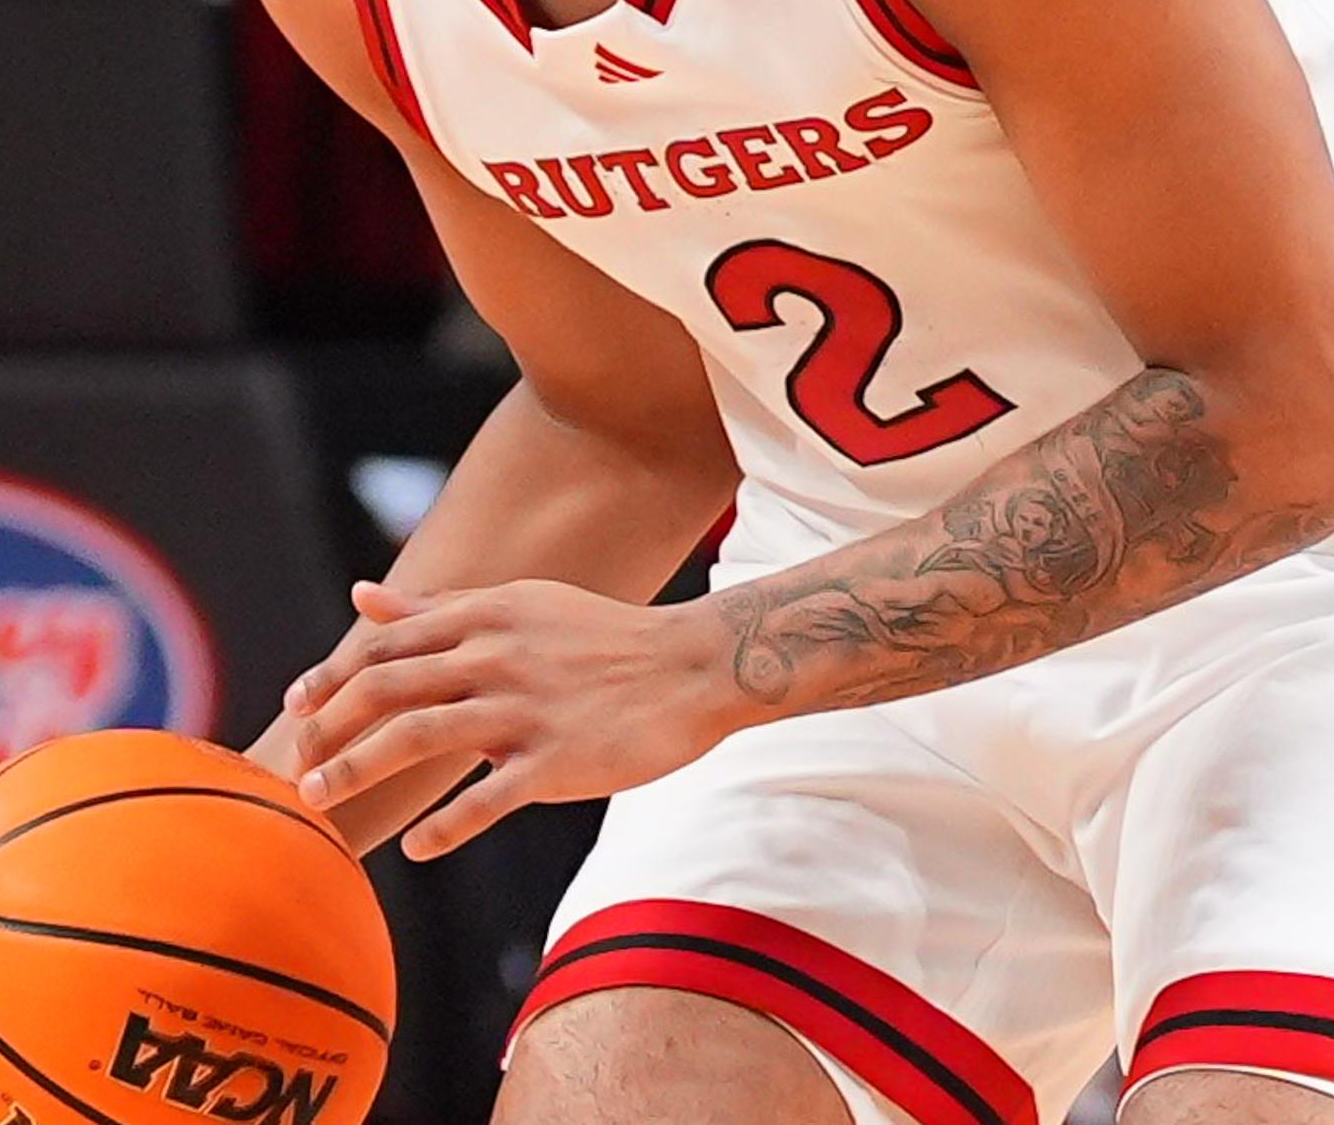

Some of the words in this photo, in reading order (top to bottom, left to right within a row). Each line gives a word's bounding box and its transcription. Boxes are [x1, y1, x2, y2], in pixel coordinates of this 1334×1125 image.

[482, 87, 934, 218] RUTGERS
[704, 237, 1019, 468] 2
[137, 988, 198, 1022] BALL
[202, 1015, 268, 1047] GAME
[107, 1010, 339, 1125] NCAA
